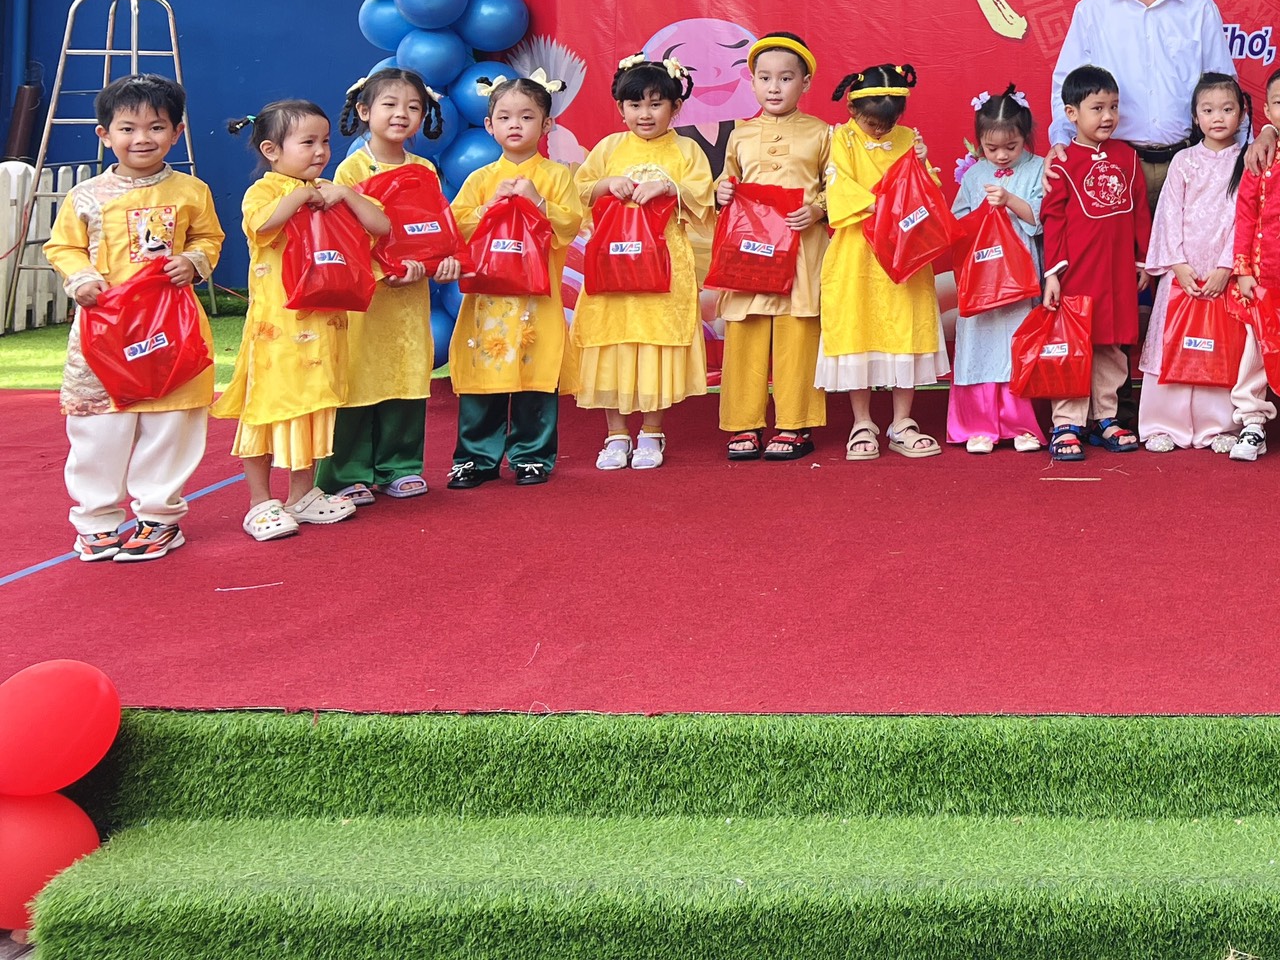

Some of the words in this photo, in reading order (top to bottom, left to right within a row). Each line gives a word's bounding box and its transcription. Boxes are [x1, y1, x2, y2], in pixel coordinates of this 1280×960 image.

[1222, 25, 1275, 63] hơ,
[908, 207, 928, 224] VAS
[415, 222, 441, 232] VAS
[500, 241, 524, 251] VAS
[618, 243, 641, 252] VAS
[749, 242, 775, 254] VAS
[980, 246, 1003, 259] VAS
[137, 334, 167, 354] VAS
[1046, 344, 1068, 355] VAS
[1193, 340, 1213, 350] VAS
